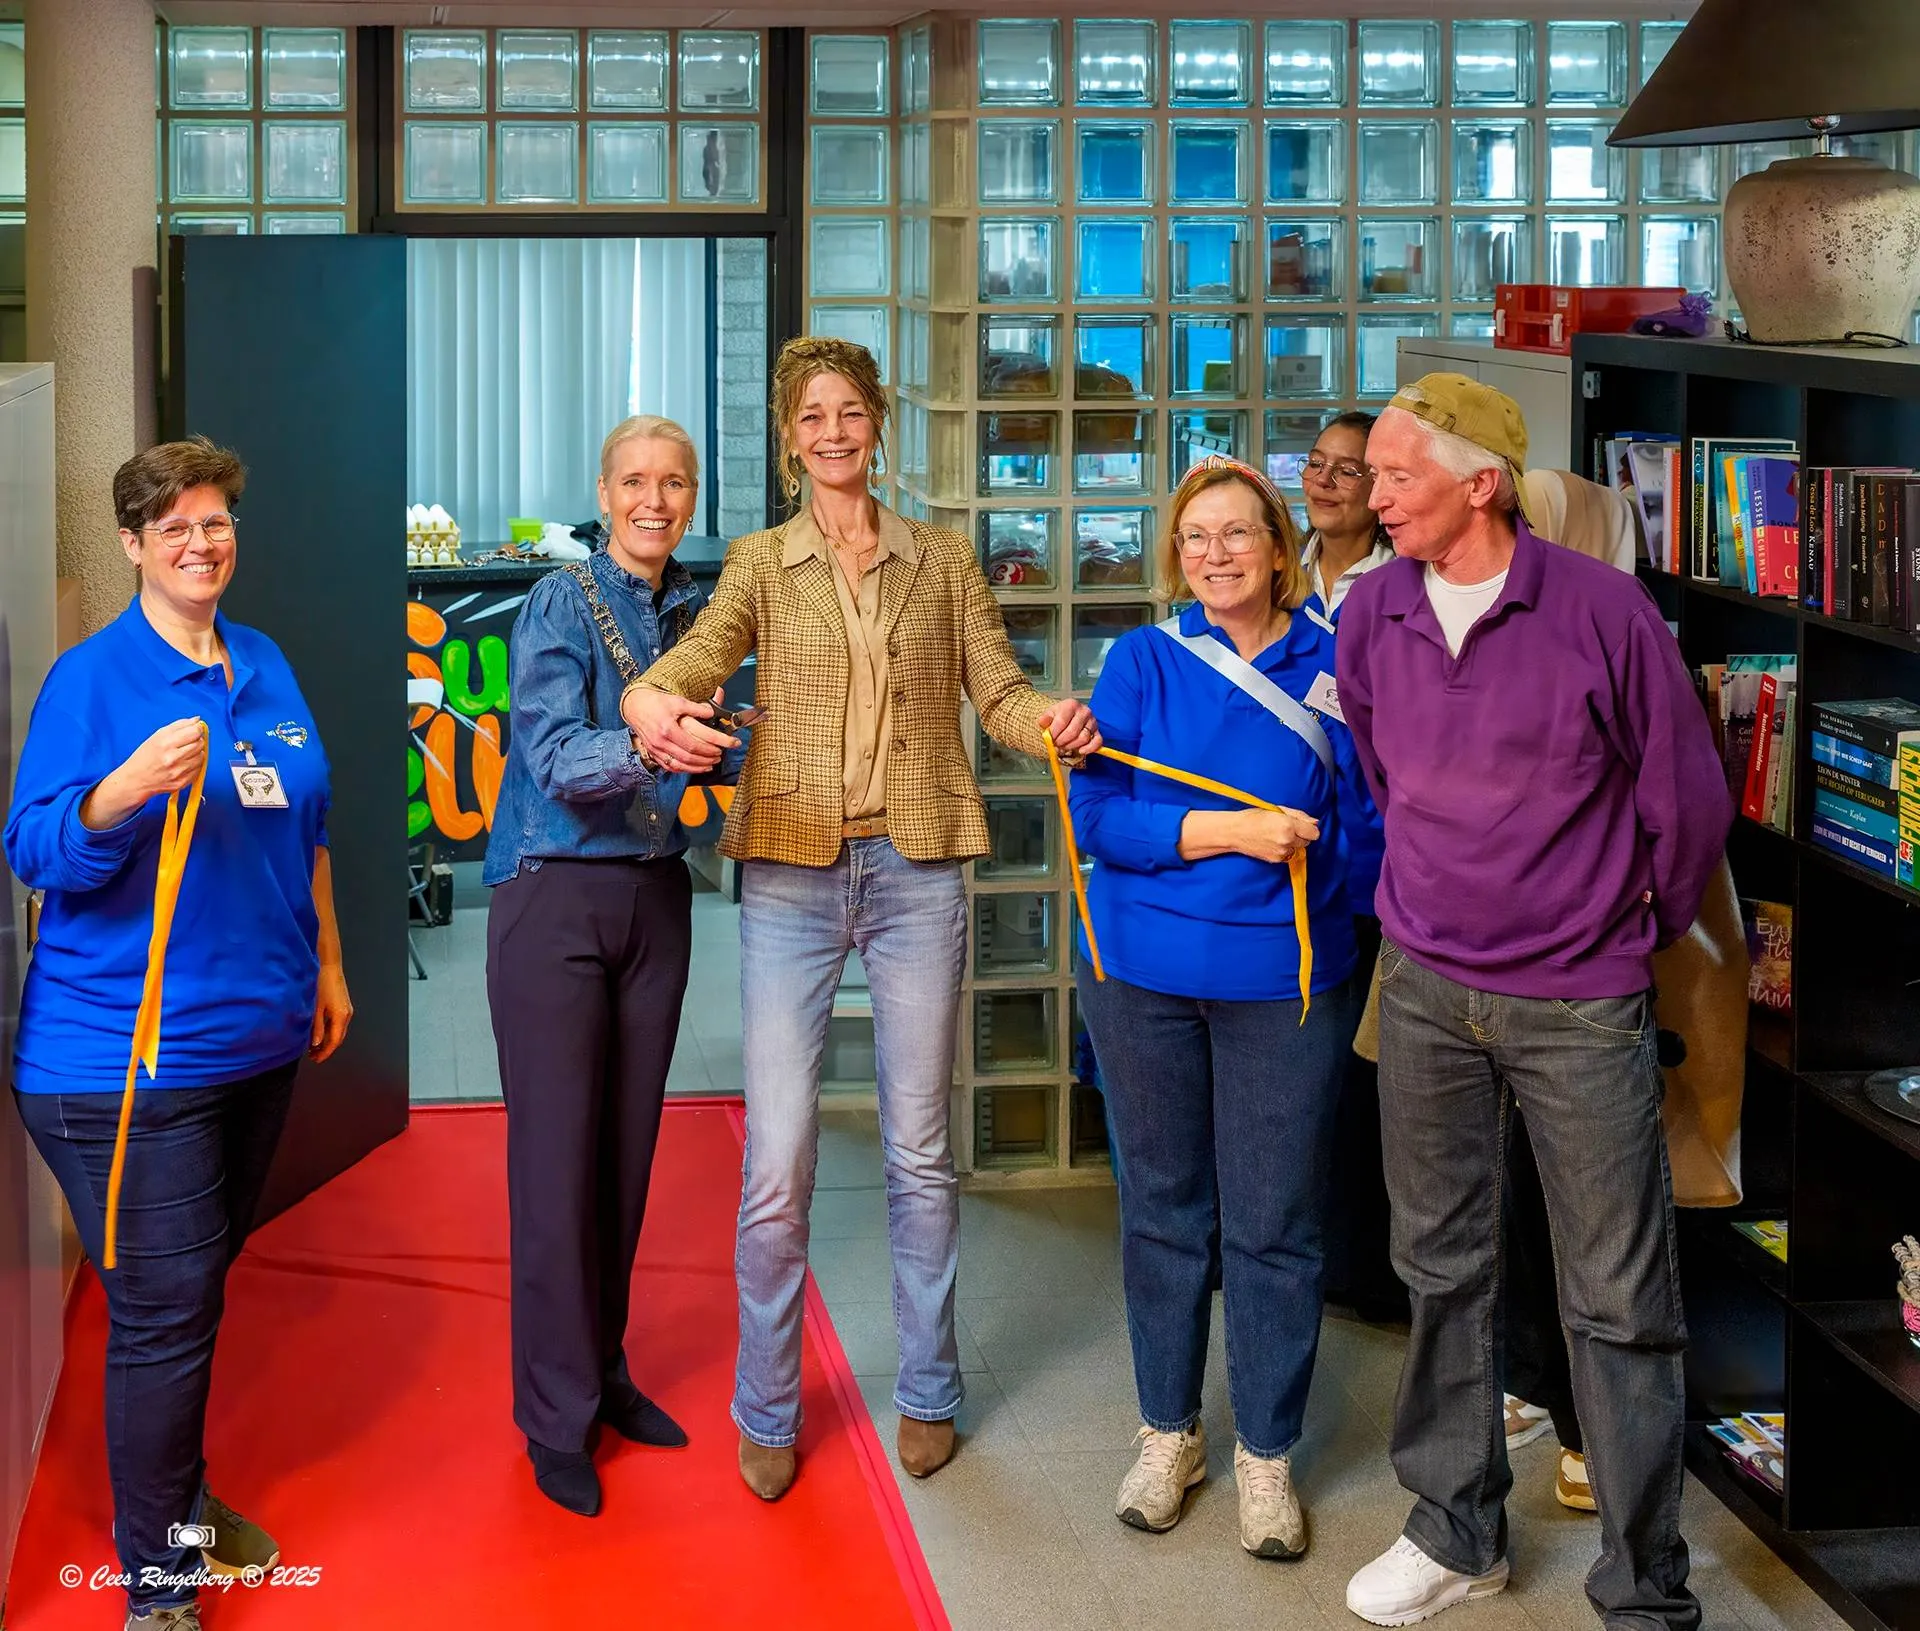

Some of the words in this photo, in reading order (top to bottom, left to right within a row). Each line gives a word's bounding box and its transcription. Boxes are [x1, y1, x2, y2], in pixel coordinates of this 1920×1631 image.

[1754, 490, 1764, 526] LESSEN
[1758, 539, 1766, 577] CHEMIE
[1808, 535, 1816, 570] KENAU
[1756, 712, 1769, 772] keukenmeiden
[1817, 765, 1832, 777] LEON
[1831, 770, 1840, 780] DE
[1839, 772, 1861, 788] WINTER
[1899, 745, 1920, 800] PLAY
[1899, 794, 1920, 846] FAIR
